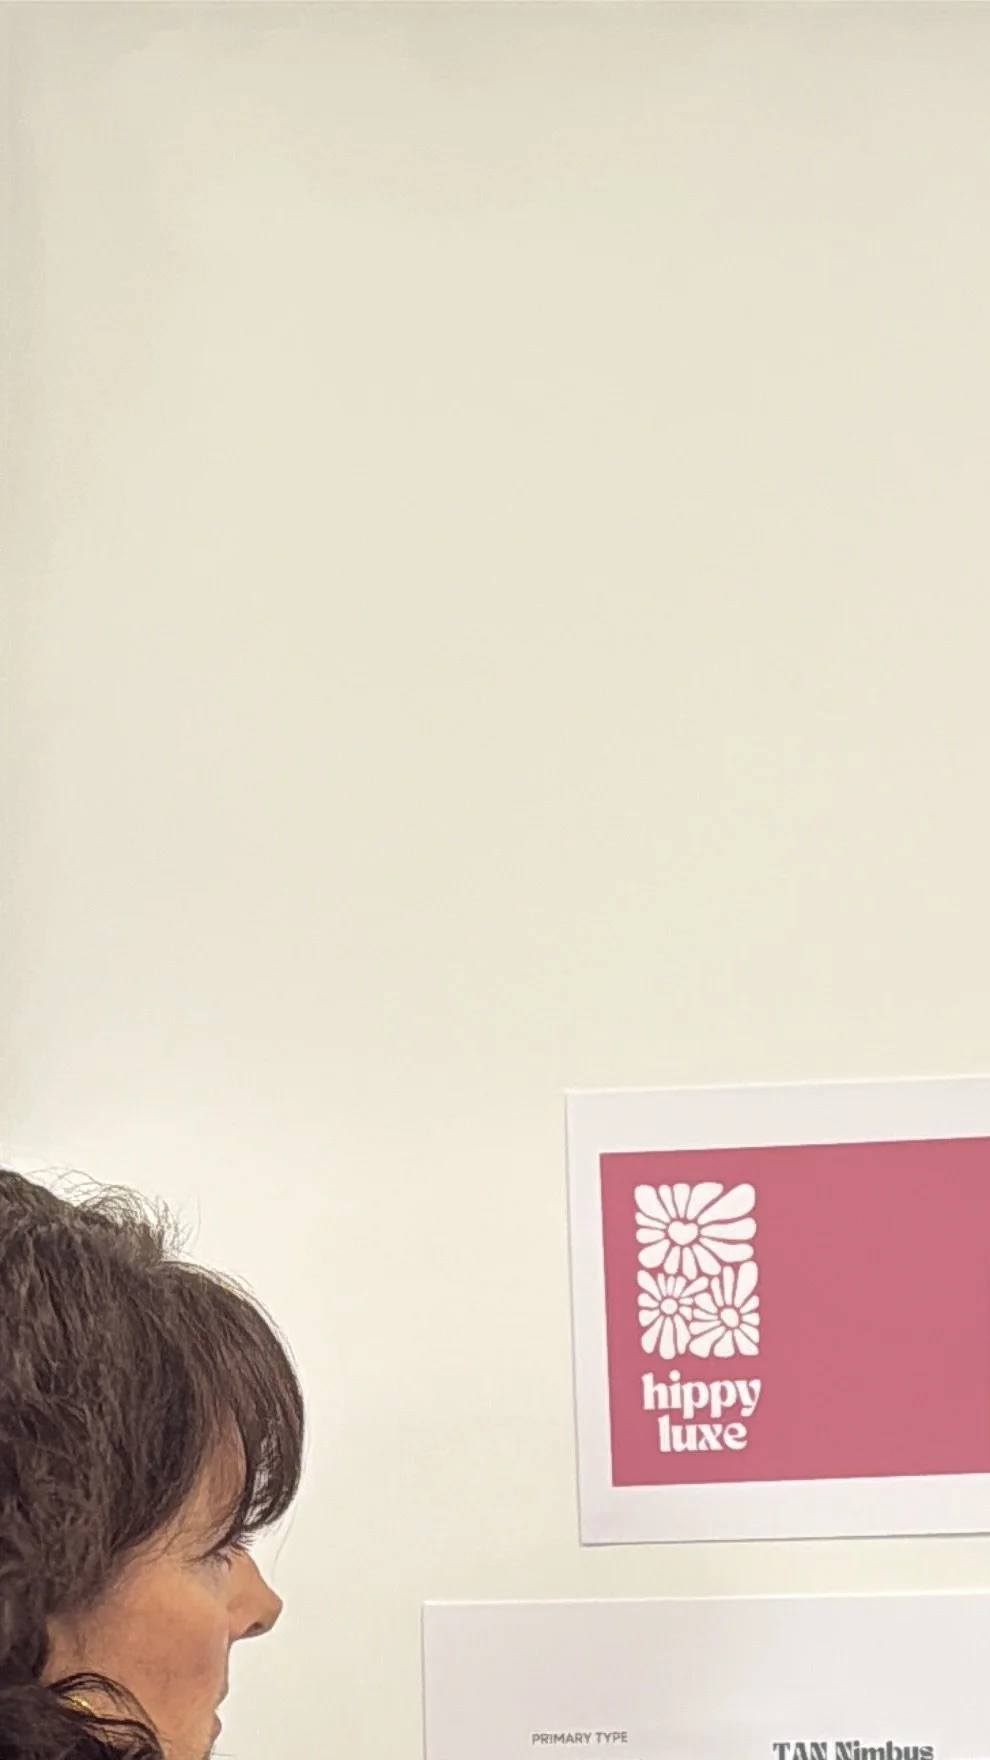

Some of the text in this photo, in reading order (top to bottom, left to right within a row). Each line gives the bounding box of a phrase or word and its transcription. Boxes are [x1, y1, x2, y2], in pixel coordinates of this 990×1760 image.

[642, 1372, 760, 1416] hippy
[659, 1418, 747, 1453] luxe
[532, 1731, 628, 1744] PRIMARY TYPE
